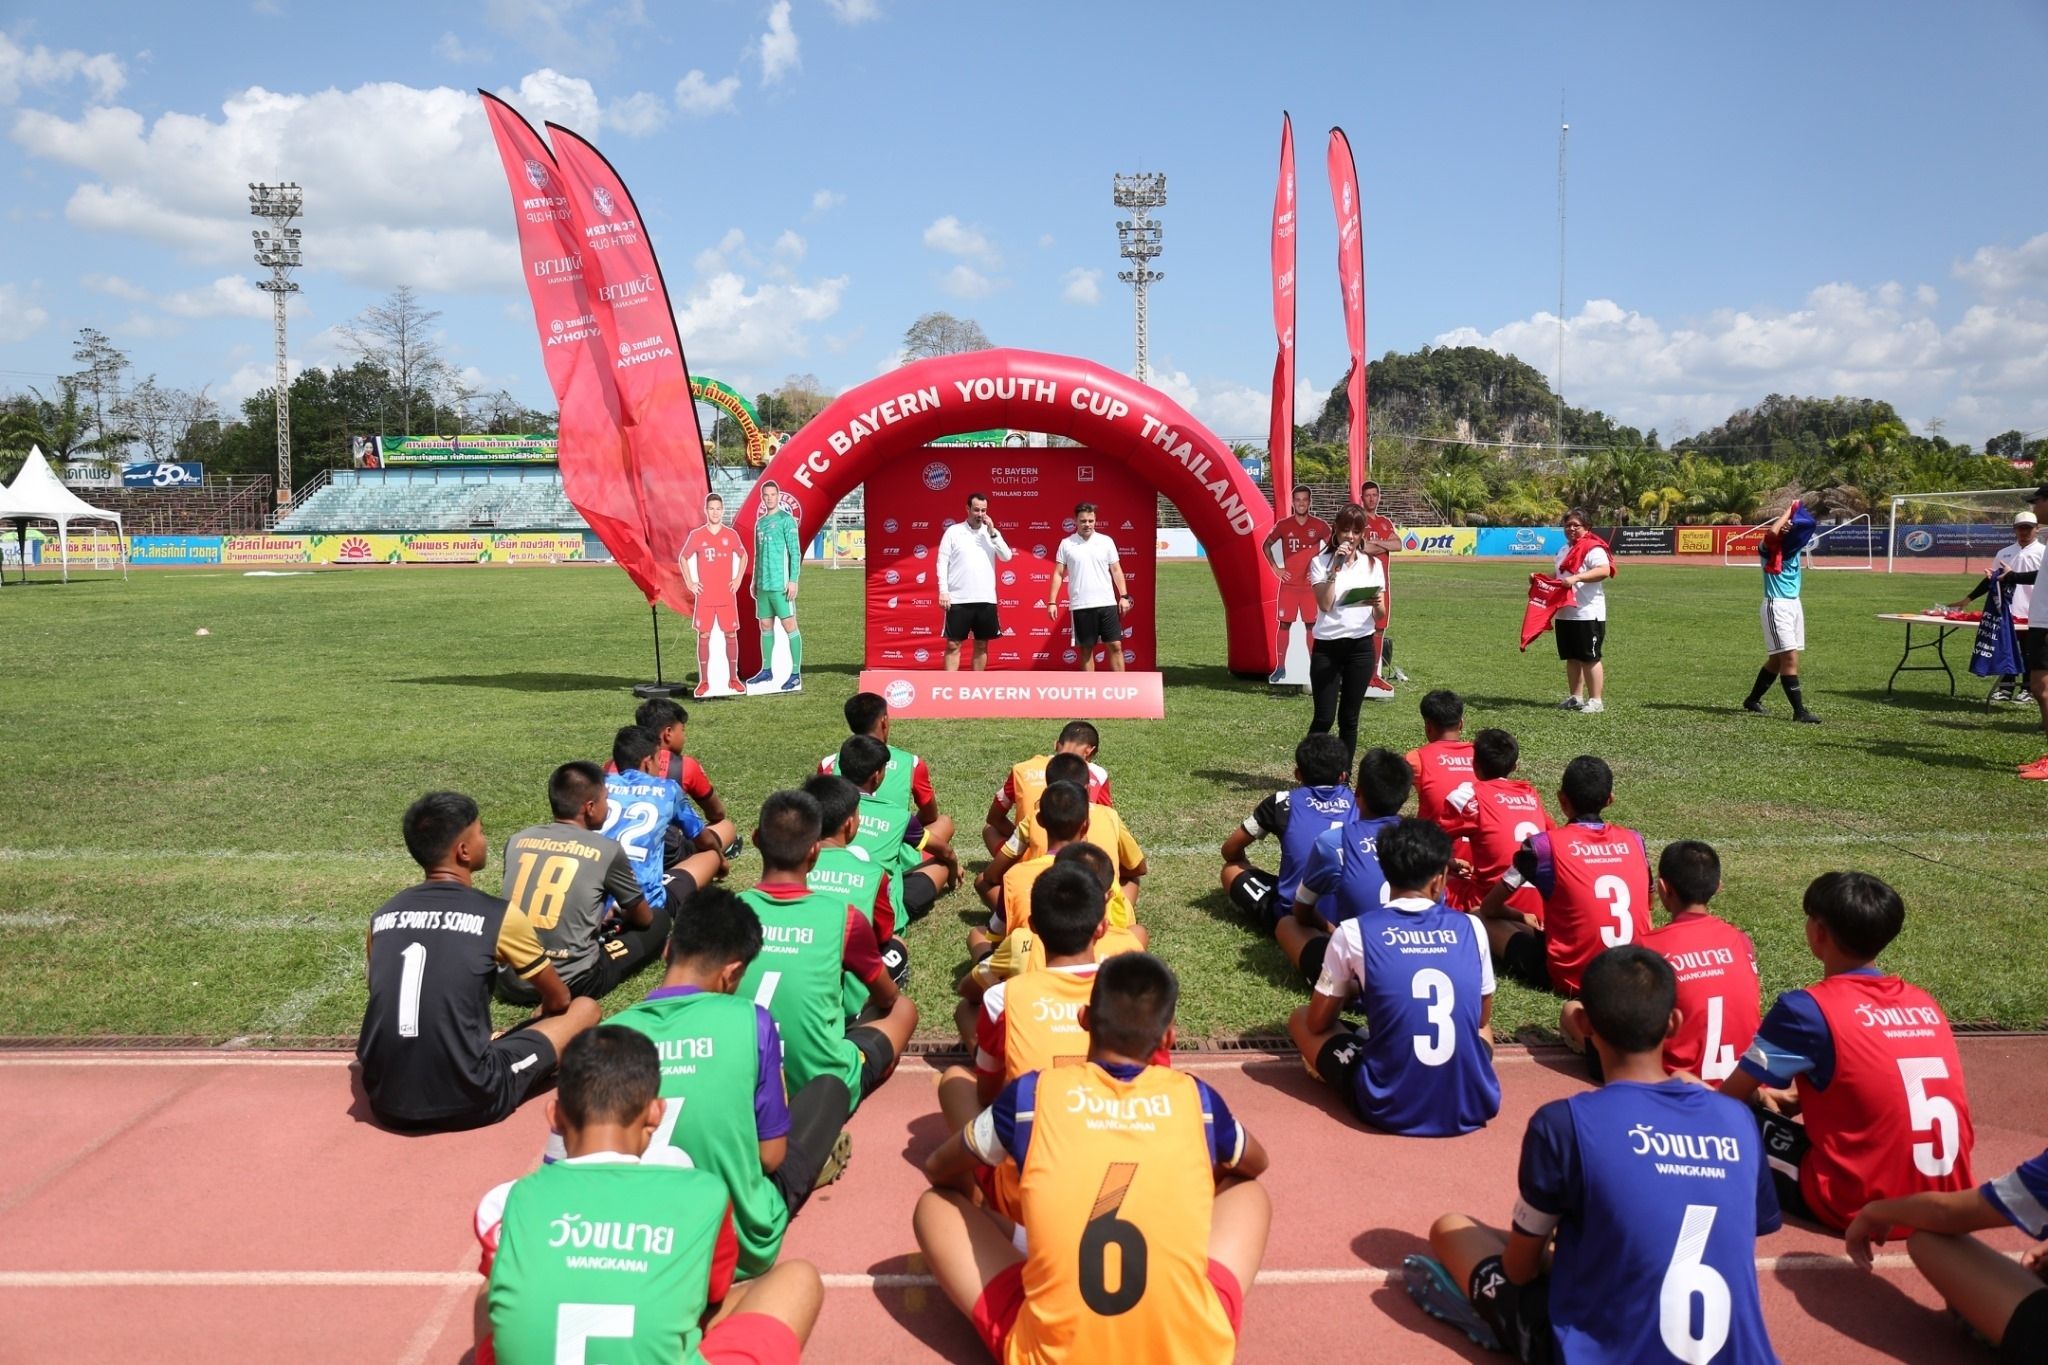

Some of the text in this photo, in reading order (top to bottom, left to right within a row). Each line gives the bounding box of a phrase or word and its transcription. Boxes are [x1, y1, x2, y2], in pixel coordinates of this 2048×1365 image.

[793, 376, 1254, 536] FC BAYERN YOUTH CUP THAILAND
[991, 467, 1038, 475] FC BAYERN
[992, 476, 1039, 484] YOUTH CUP
[1420, 534, 1456, 552] ptt
[931, 687, 955, 700] FC
[959, 687, 1031, 700] BAYERN
[1036, 687, 1097, 700] YOUTH
[1102, 687, 1139, 700] CUP
[1568, 840, 1630, 858] วังขนาย
[511, 852, 580, 931] 18
[396, 911, 442, 930] SPORTS
[442, 911, 486, 937] SCHOOL
[1594, 874, 1634, 948] 3
[1381, 926, 1458, 946] วังขนาย
[398, 942, 427, 1038] 1
[1677, 968, 1724, 983] WANGKANAI
[1411, 968, 1456, 1067] 3
[1854, 1002, 1941, 1028] วังขนาย
[1701, 996, 1740, 1082] 4
[1882, 1028, 1936, 1040] WANGKANAI
[1066, 1085, 1172, 1120] วังขนาย
[1896, 1056, 1960, 1177] 5
[1628, 1123, 1741, 1162] วังขนาย
[1654, 1162, 1726, 1180] WANGKANAI
[548, 1212, 674, 1256] วังขนาย
[1078, 1162, 1148, 1317] 6
[566, 1255, 648, 1273] WANGKANAI
[1659, 1204, 1732, 1365] 6
